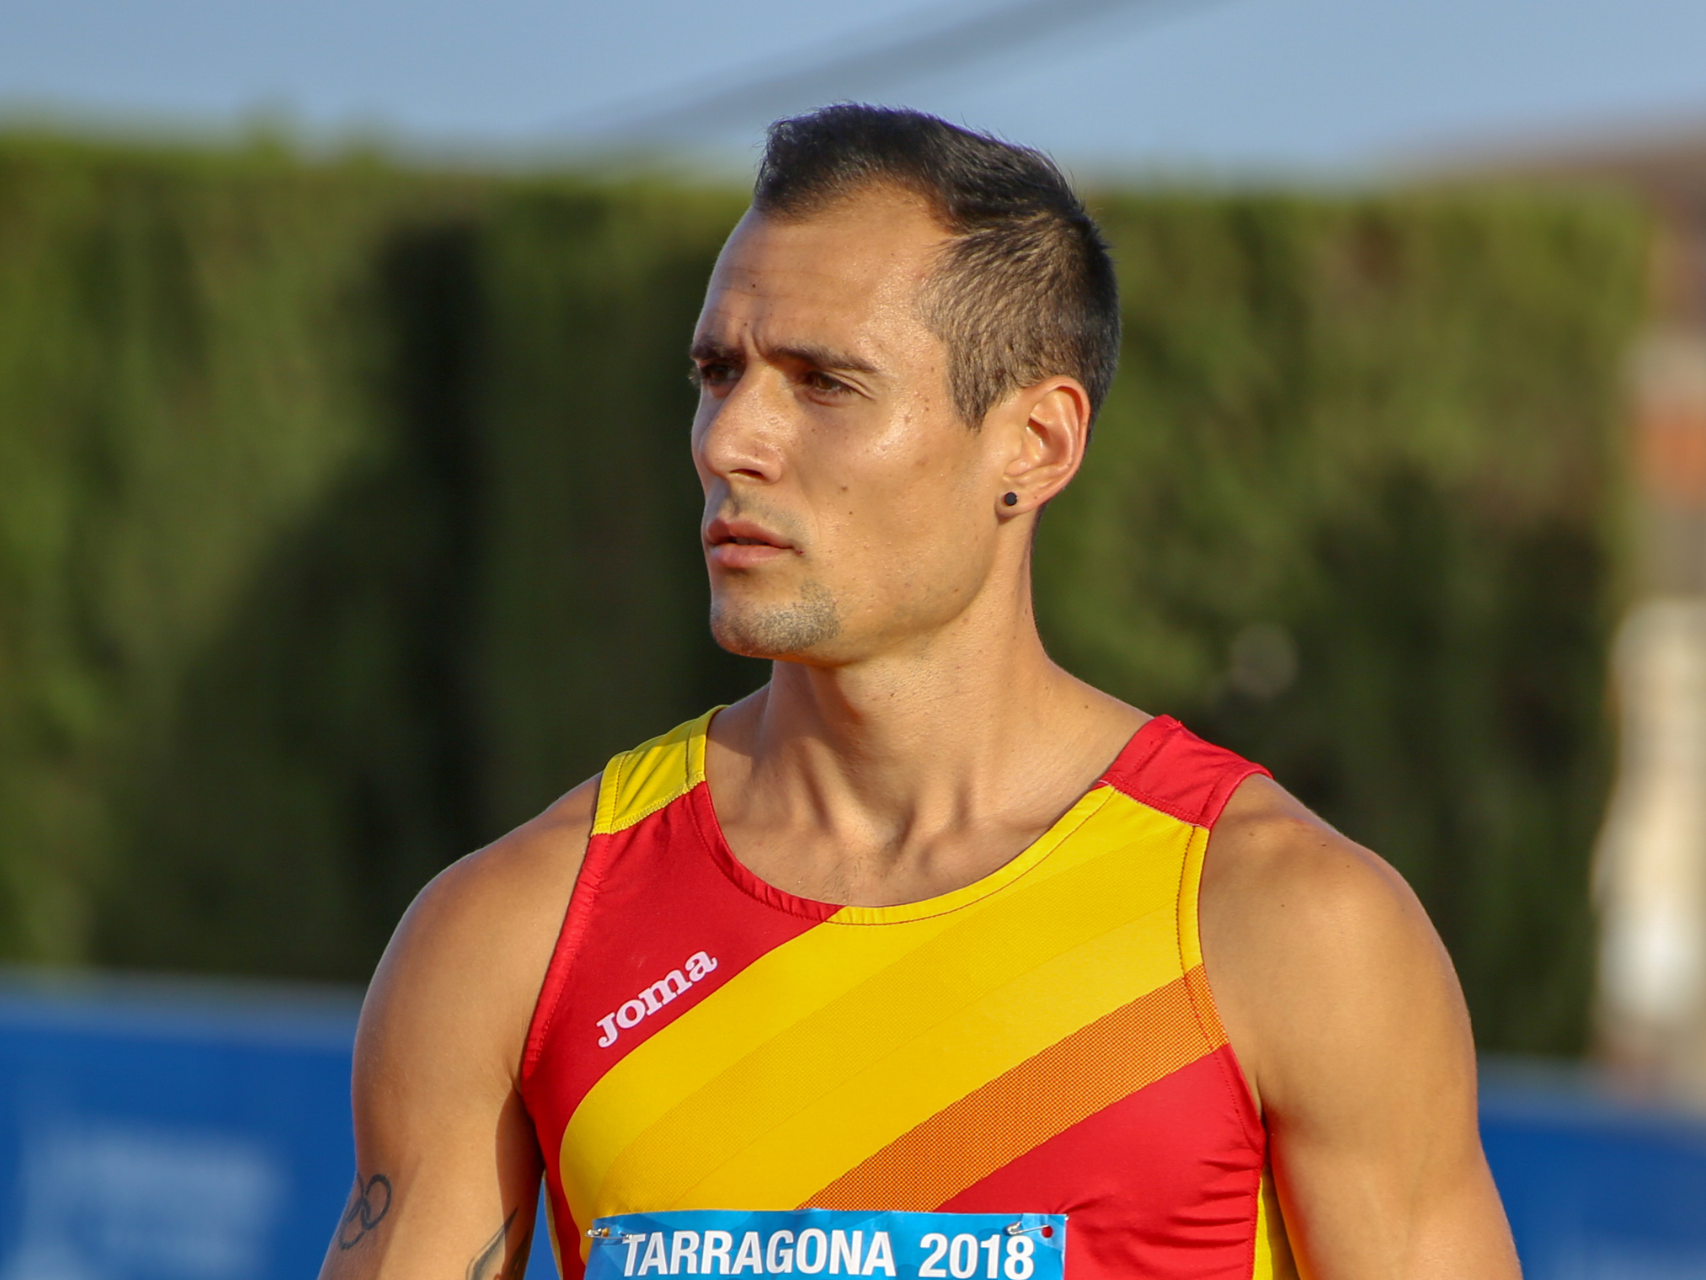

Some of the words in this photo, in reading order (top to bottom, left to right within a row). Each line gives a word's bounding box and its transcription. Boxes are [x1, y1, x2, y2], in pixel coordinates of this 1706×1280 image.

[596, 951, 718, 1048] Joma
[622, 1228, 896, 1277] TARRAGONA
[918, 1233, 1035, 1280] 2018
